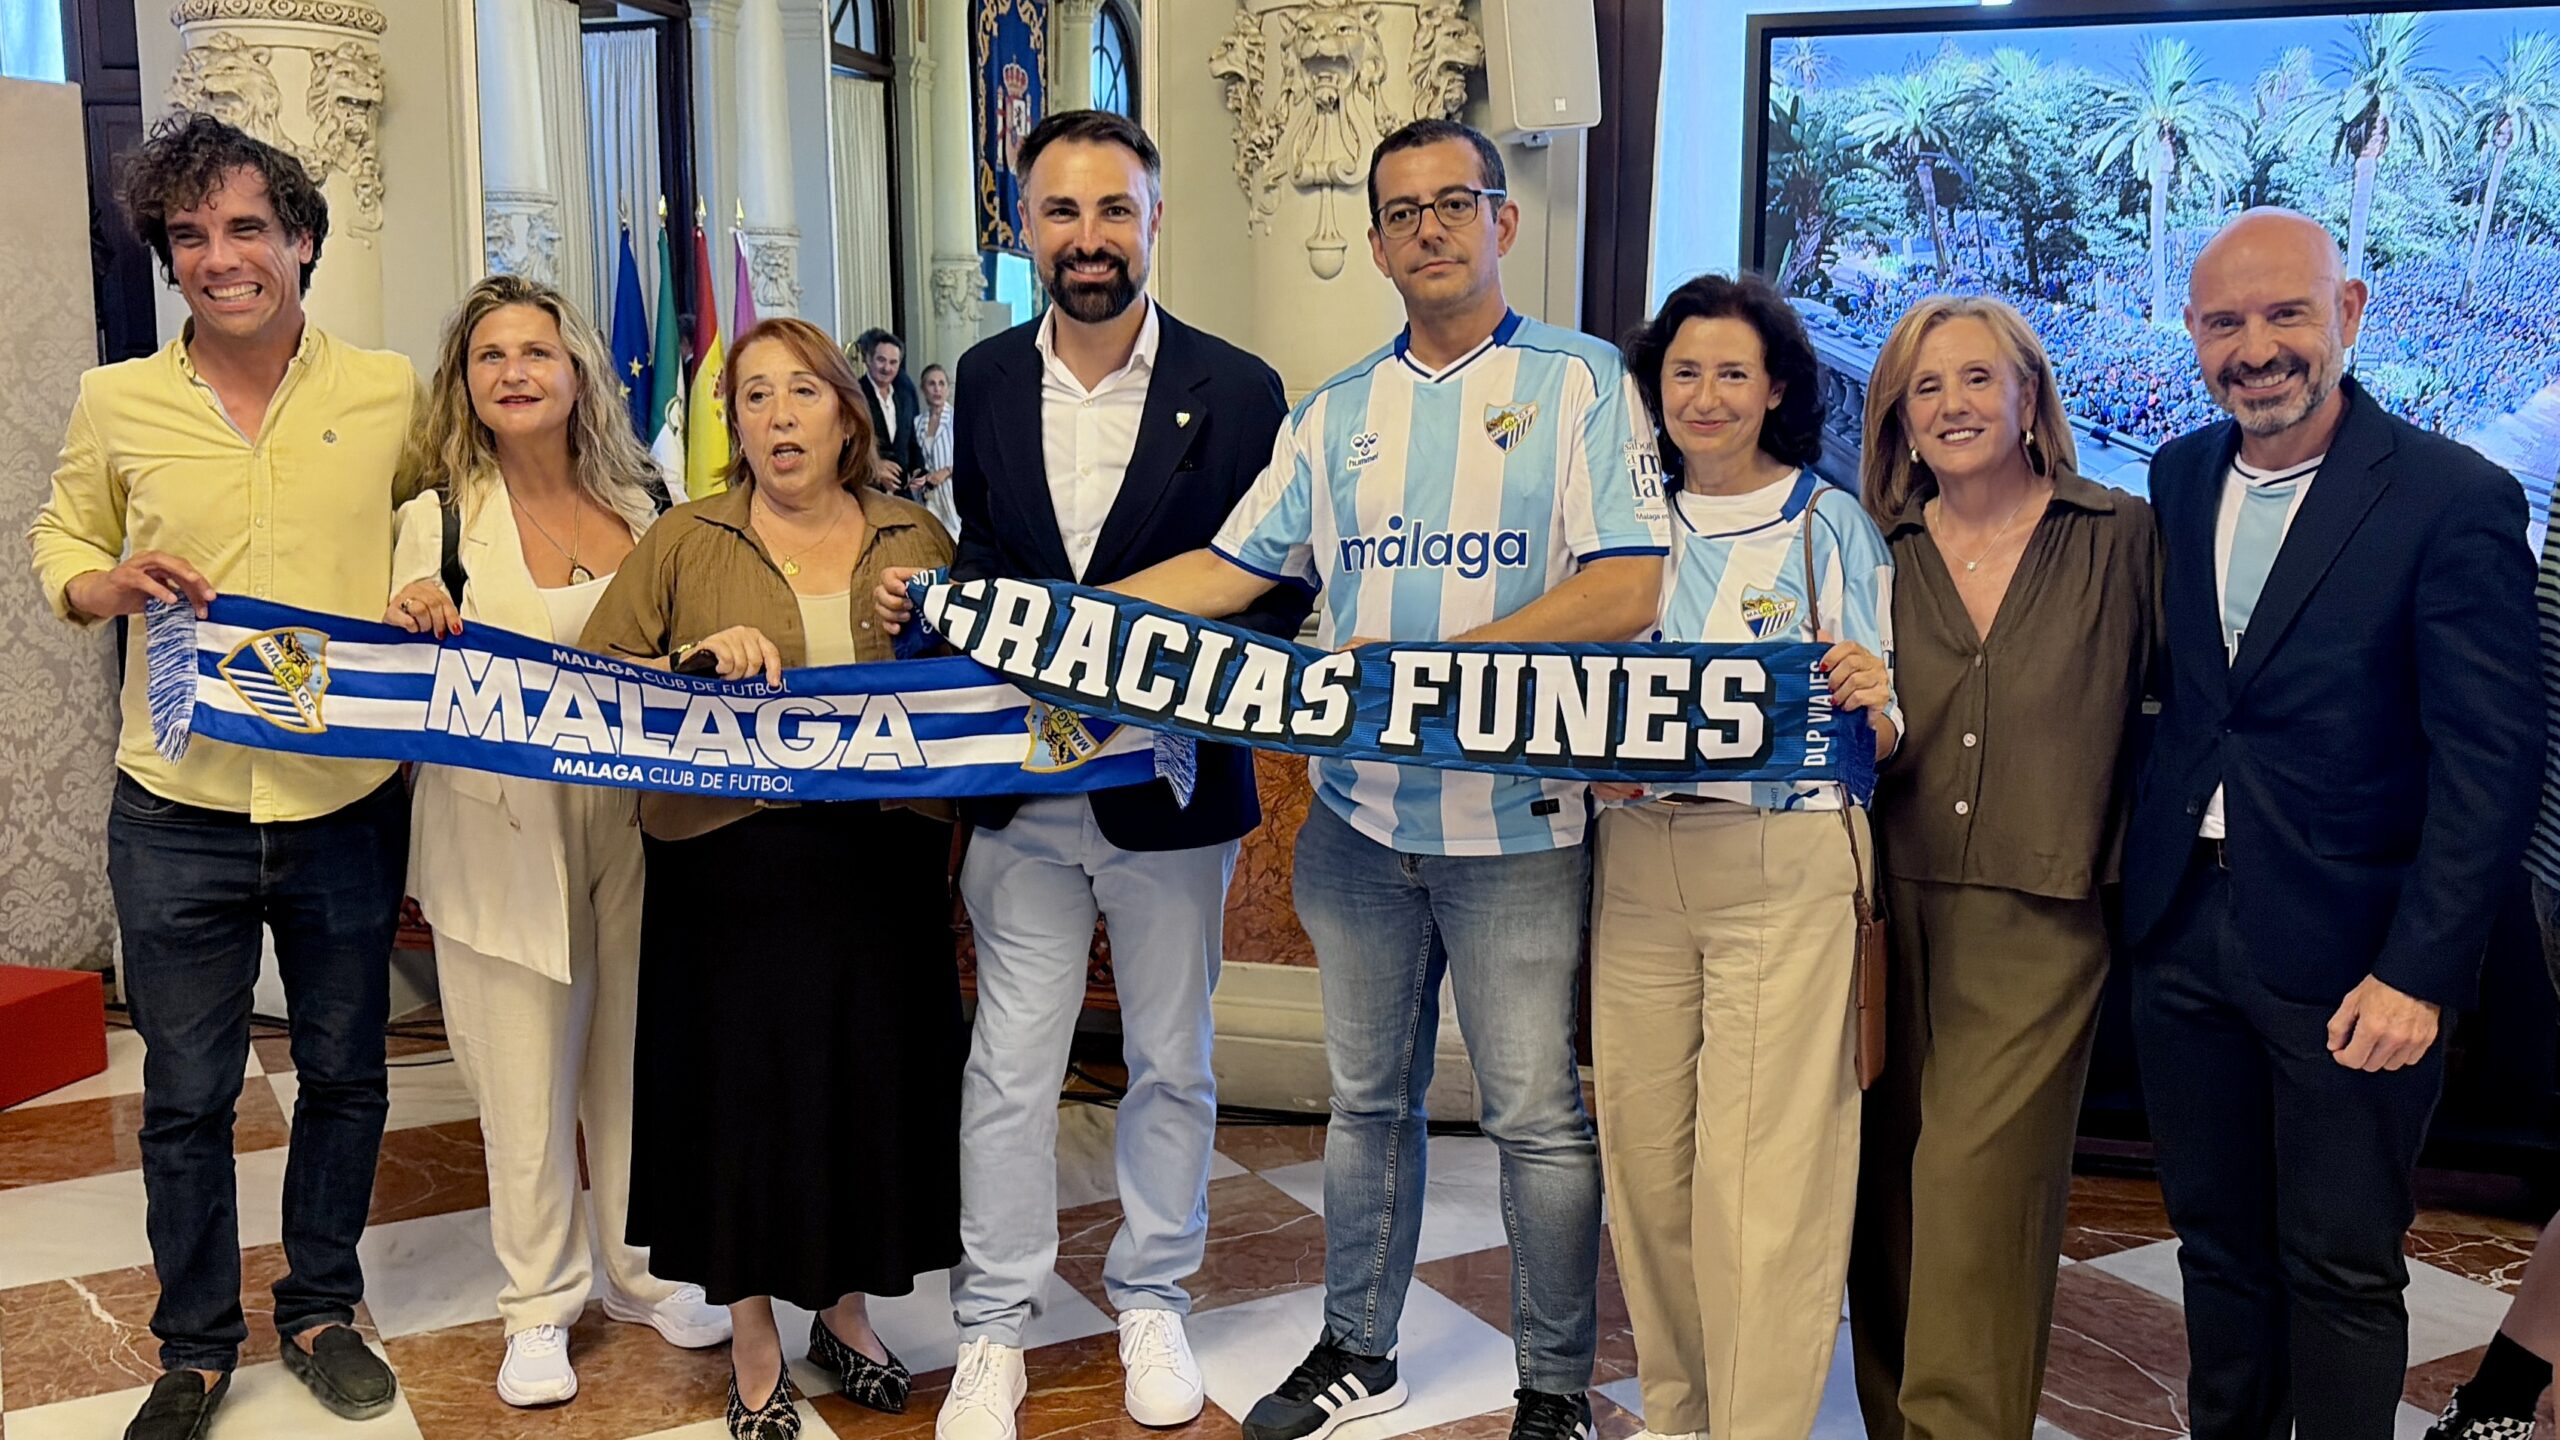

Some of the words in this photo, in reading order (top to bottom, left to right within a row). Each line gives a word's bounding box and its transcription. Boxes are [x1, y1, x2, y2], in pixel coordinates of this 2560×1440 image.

[1348, 452, 1379, 468] hummel
[1639, 453, 1660, 475] m
[261, 641, 301, 693] MALAGA
[552, 649, 640, 679] MALAGA
[641, 671, 688, 690] CLUB
[692, 680, 717, 693] DE
[722, 679, 792, 697] FUTBOL
[923, 577, 1357, 738] GRACIAS
[425, 647, 927, 771] MALAGA
[1379, 650, 1767, 760] FUNES
[1055, 707, 1092, 752] MALAG
[1803, 729, 1831, 767] DLP
[552, 757, 644, 783] MALAGA
[648, 766, 695, 787] CLUB
[700, 773, 724, 790] DE
[729, 775, 795, 793] FUTBOL
